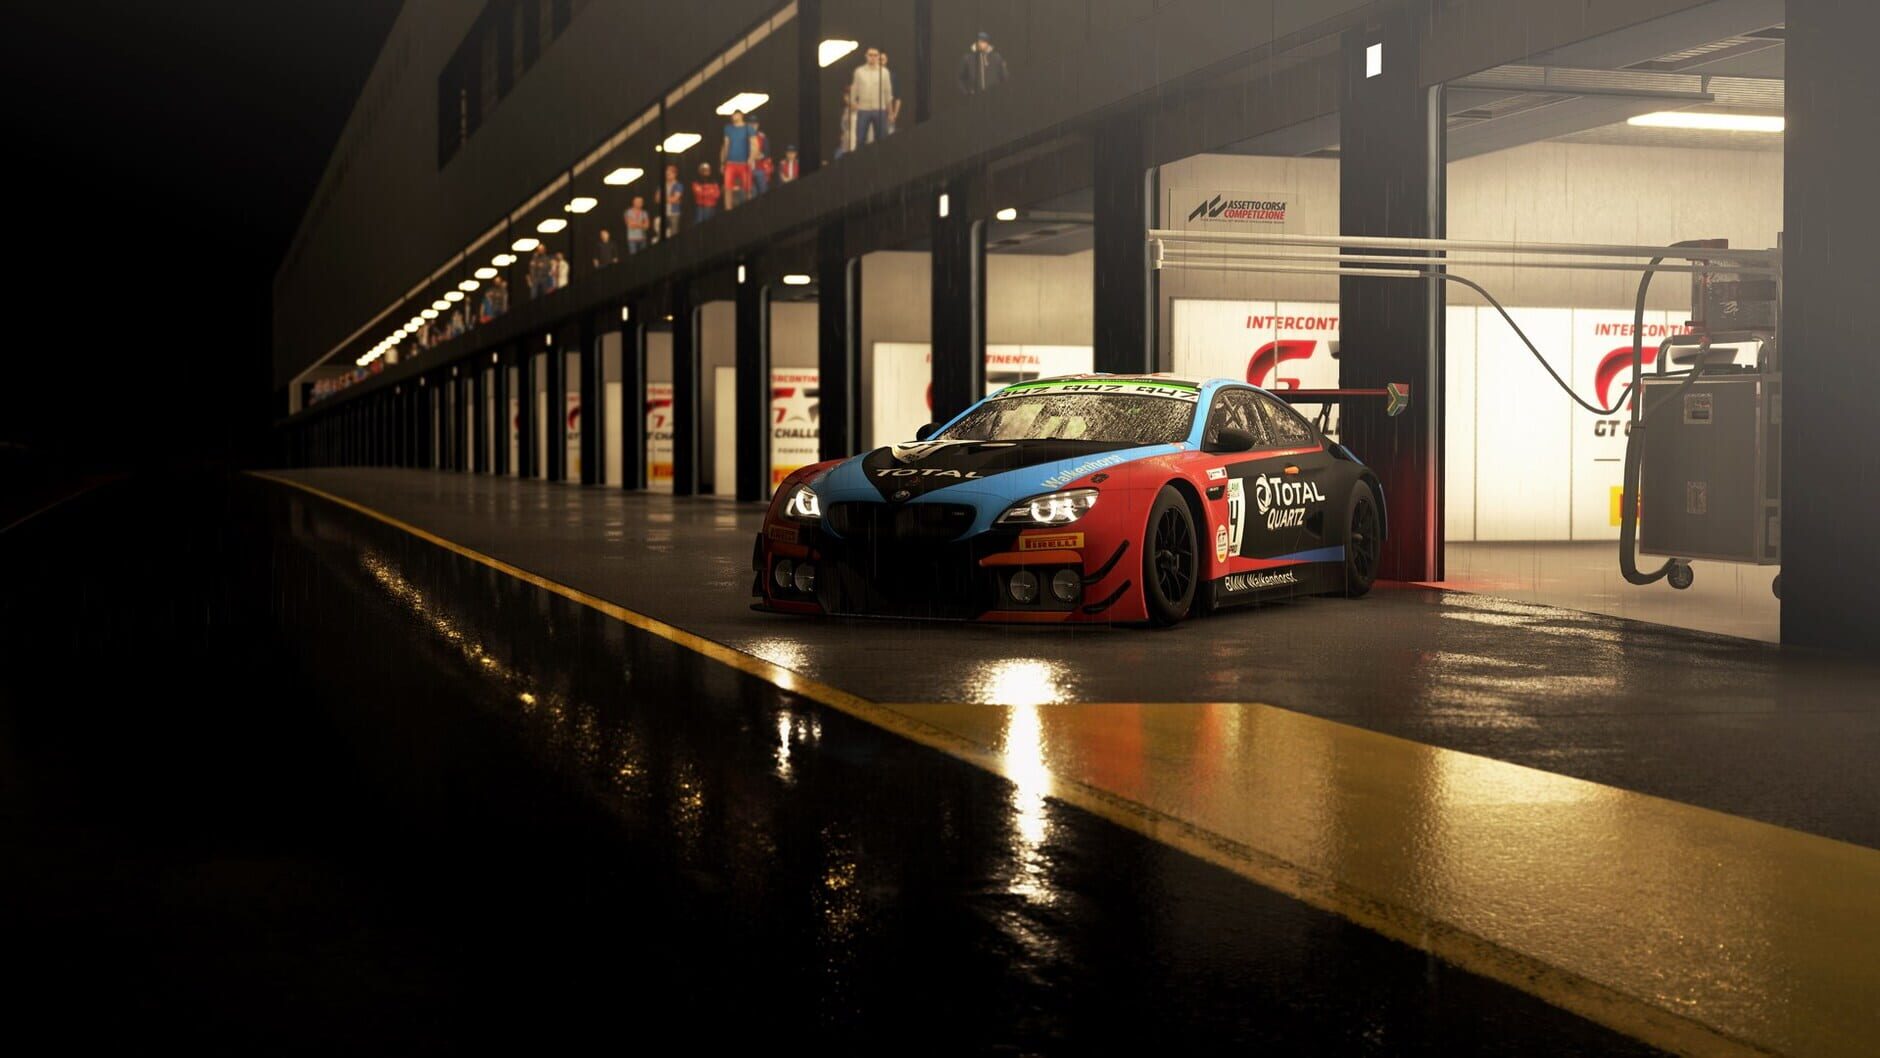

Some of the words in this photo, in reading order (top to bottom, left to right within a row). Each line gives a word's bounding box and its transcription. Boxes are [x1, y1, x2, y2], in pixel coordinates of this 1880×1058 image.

[1228, 200, 1261, 210] ASSETTO
[1262, 202, 1286, 211] CORSA
[1224, 210, 1286, 220] COMPETIZIONE
[1246, 315, 1340, 330] INTERCONT
[1594, 420, 1620, 437] GT
[876, 468, 985, 479] TOTAL
[1269, 477, 1326, 506] TOTAL
[1267, 507, 1306, 530] QUARTZ
[1024, 535, 1079, 549] PIRELLI
[1225, 575, 1249, 592] BMW
[1247, 570, 1298, 588] Walkenhorst
